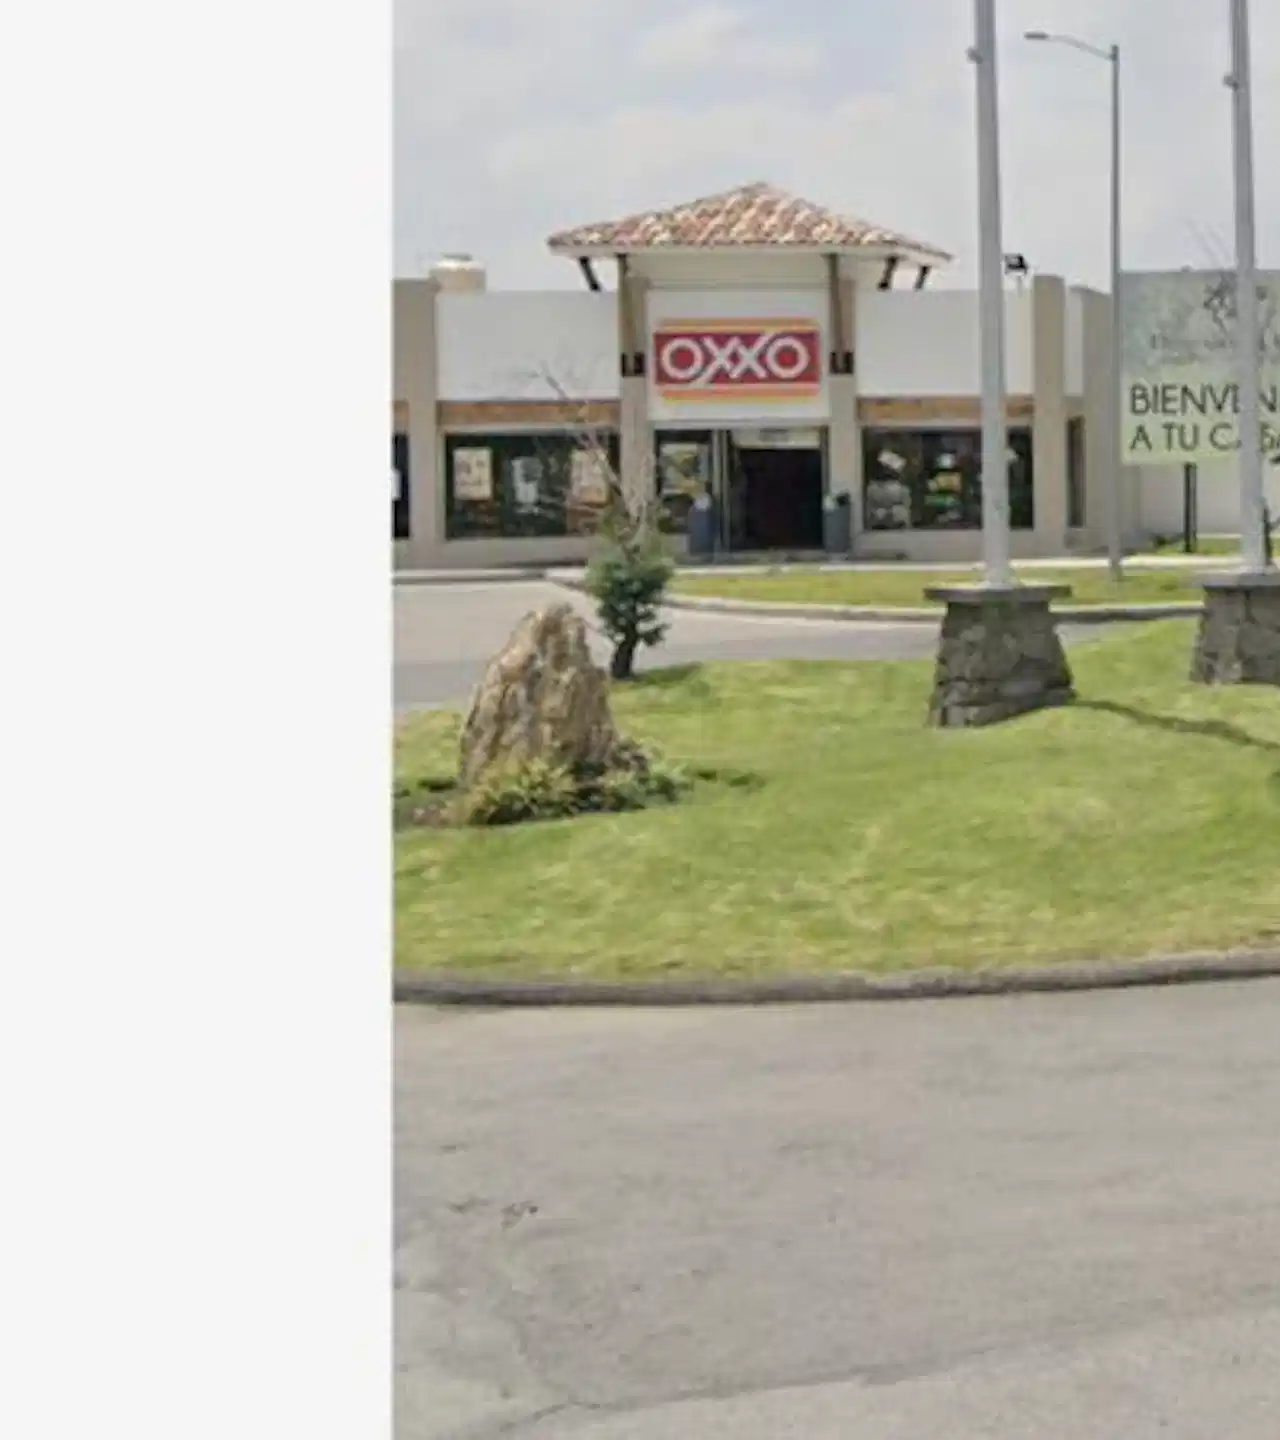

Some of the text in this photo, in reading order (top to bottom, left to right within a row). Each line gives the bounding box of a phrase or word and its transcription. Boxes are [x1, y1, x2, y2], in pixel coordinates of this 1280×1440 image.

[661, 332, 810, 386] OXXO
[1130, 424, 1152, 452] A
[1162, 421, 1199, 452] TU
